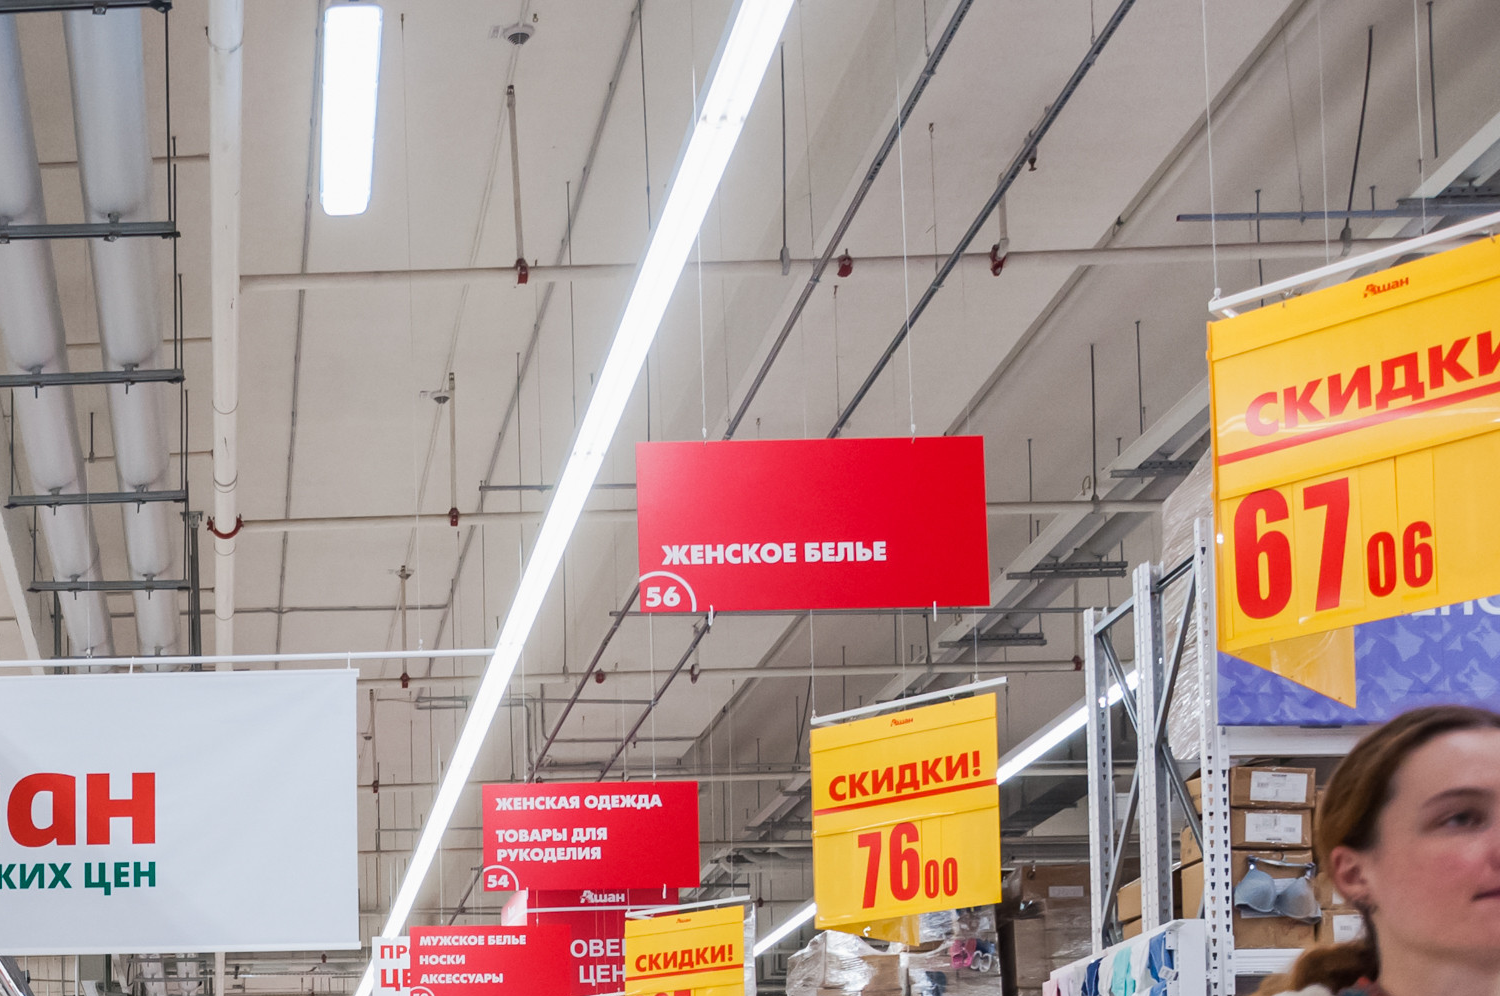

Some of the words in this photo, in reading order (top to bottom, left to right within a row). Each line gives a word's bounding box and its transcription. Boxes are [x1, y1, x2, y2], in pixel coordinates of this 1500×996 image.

[661, 541, 797, 566] ЖЕНСКОЕ
[804, 541, 887, 562] БЕЛЬЕ
[645, 586, 680, 607] 56
[829, 751, 981, 802] СКИДКИ!
[496, 796, 580, 811] ЖЕНСКАЯ
[584, 794, 662, 809] ОДЕЖДА
[496, 829, 568, 843] ТОВАРЫ
[571, 828, 608, 843] ДЛЯ
[497, 847, 602, 863] РУКОДЕЛИЯ
[84, 861, 157, 897] ЦЕН
[488, 874, 509, 888] 54
[580, 890, 625, 903] Ашан
[420, 935, 485, 946] МУЖСКОЕ
[488, 935, 527, 945] БЕЛЬЕ
[419, 954, 466, 965] НОСКИ
[635, 944, 733, 974] СКИДКИ!
[420, 973, 503, 984] АКСЕССУАРЫ
